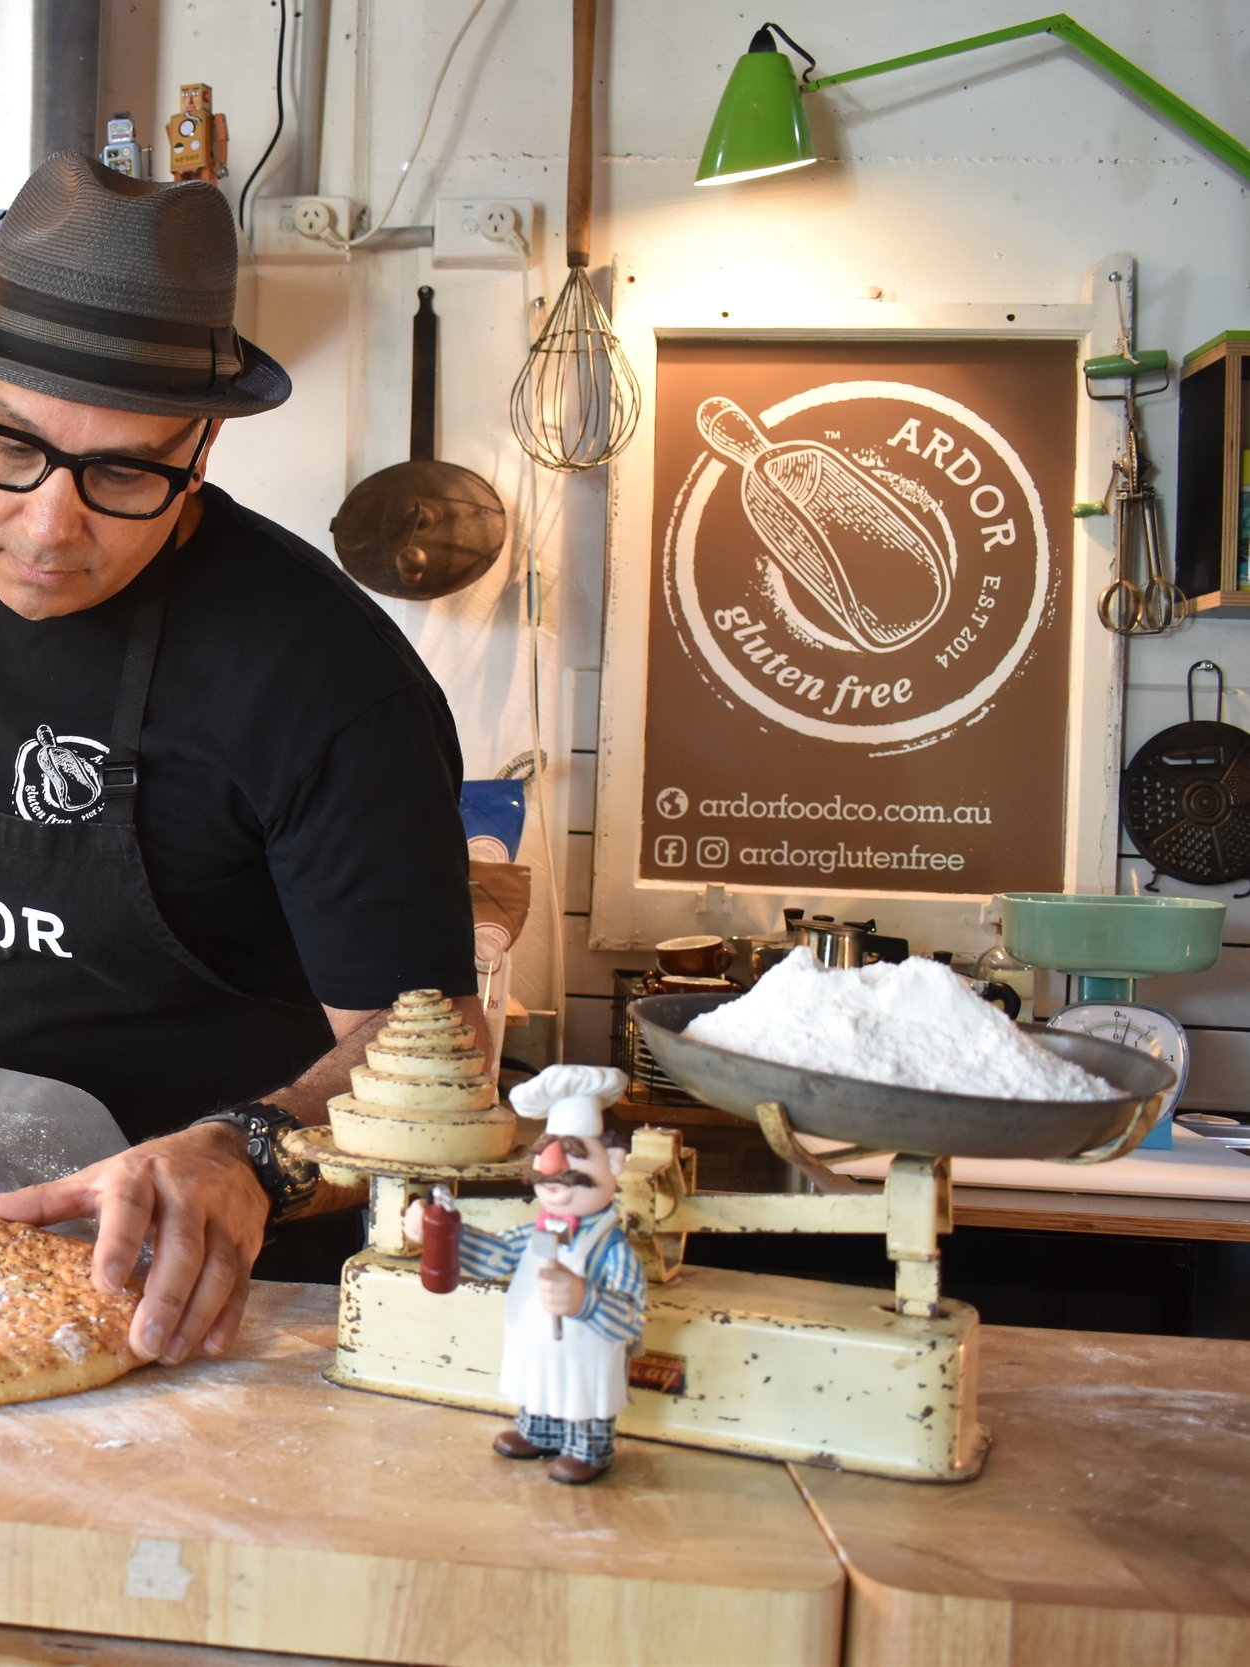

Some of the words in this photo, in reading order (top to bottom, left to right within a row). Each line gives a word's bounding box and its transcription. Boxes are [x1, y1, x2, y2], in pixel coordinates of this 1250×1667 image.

[887, 417, 1017, 552] ARDOR
[714, 604, 825, 701] gluten
[822, 676, 913, 714] free
[934, 626, 978, 669] 2014
[25, 785, 46, 820] gluten
[699, 796, 992, 825] ardorfoodco.com.au
[739, 842, 965, 873] ardorglutenfree
